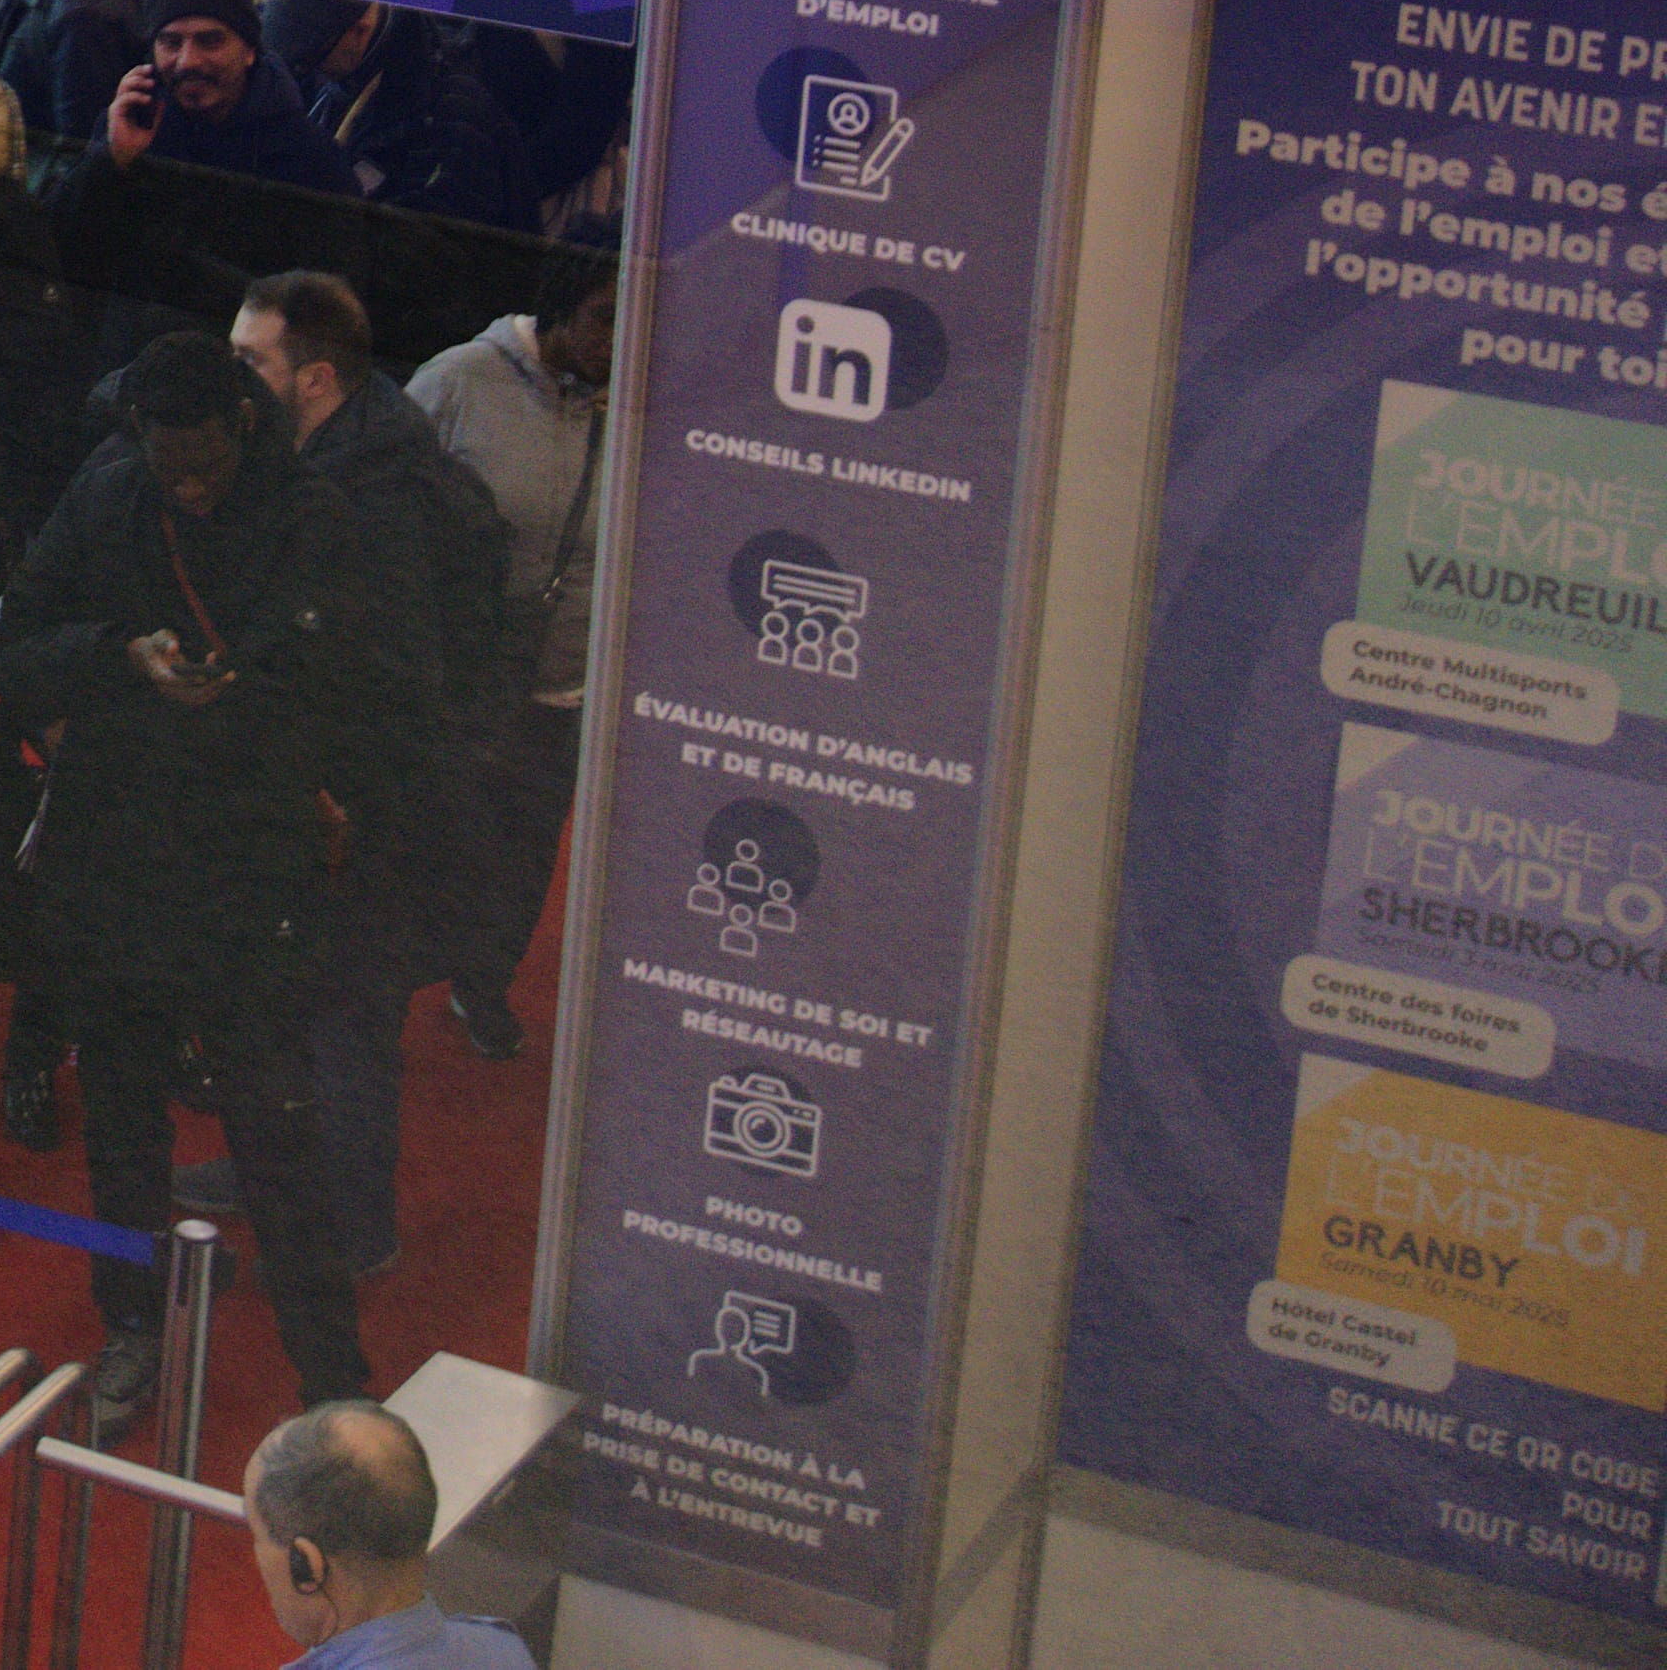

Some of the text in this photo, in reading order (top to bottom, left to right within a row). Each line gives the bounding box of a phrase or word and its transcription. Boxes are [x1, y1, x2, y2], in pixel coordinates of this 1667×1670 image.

[1397, 2, 1532, 62] ENVIE
[1544, 25, 1607, 72] DE
[1351, 60, 1667, 148] TON AVENIR E
[1236, 119, 1470, 190] Participe
[1484, 155, 1515, 197] à
[1531, 172, 1626, 212] nos
[731, 212, 965, 272] CLINIQUE DE CV
[1321, 190, 1386, 230] de
[791, 315, 872, 405] in
[1460, 328, 1585, 374] pour
[685, 429, 971, 502] CONSEILS LINKEDIN
[1417, 449, 1659, 530] JOURNÉE
[1397, 591, 1469, 622] Jeudi
[1405, 550, 1667, 635] VAUDREUIL
[1349, 666, 1547, 720] André-Chagnon
[1352, 639, 1587, 701] Centre Multisports
[634, 691, 809, 752] ÉVALUATION
[682, 742, 914, 810] ET DE FRANÇAIS
[1372, 788, 1612, 871] JOURNÉE
[624, 958, 932, 1046] MARKETING DE SOI ET
[1309, 998, 1488, 1052] de Sherbrooke
[1312, 972, 1520, 1034] Centre des foires
[682, 1008, 862, 1068] RÉSEAUTAGE
[1335, 1117, 1572, 1206] JOURNÉE
[623, 1209, 882, 1292] PROFESSIONNELLE
[705, 1195, 803, 1237] PHOTO
[1323, 1214, 1520, 1288] GRANBY
[1268, 1324, 1390, 1367] de Granby
[1271, 1298, 1417, 1346] Hôtel Castel
[602, 1403, 866, 1490] PRÉPARATION À LA
[1327, 1386, 1660, 1497] SCANNE CE QR CODE
[583, 1431, 881, 1527] PRISE DE CONTACT ET
[1436, 1500, 1647, 1581] TOUT SAVOIR
[1561, 1490, 1653, 1541] POUR
